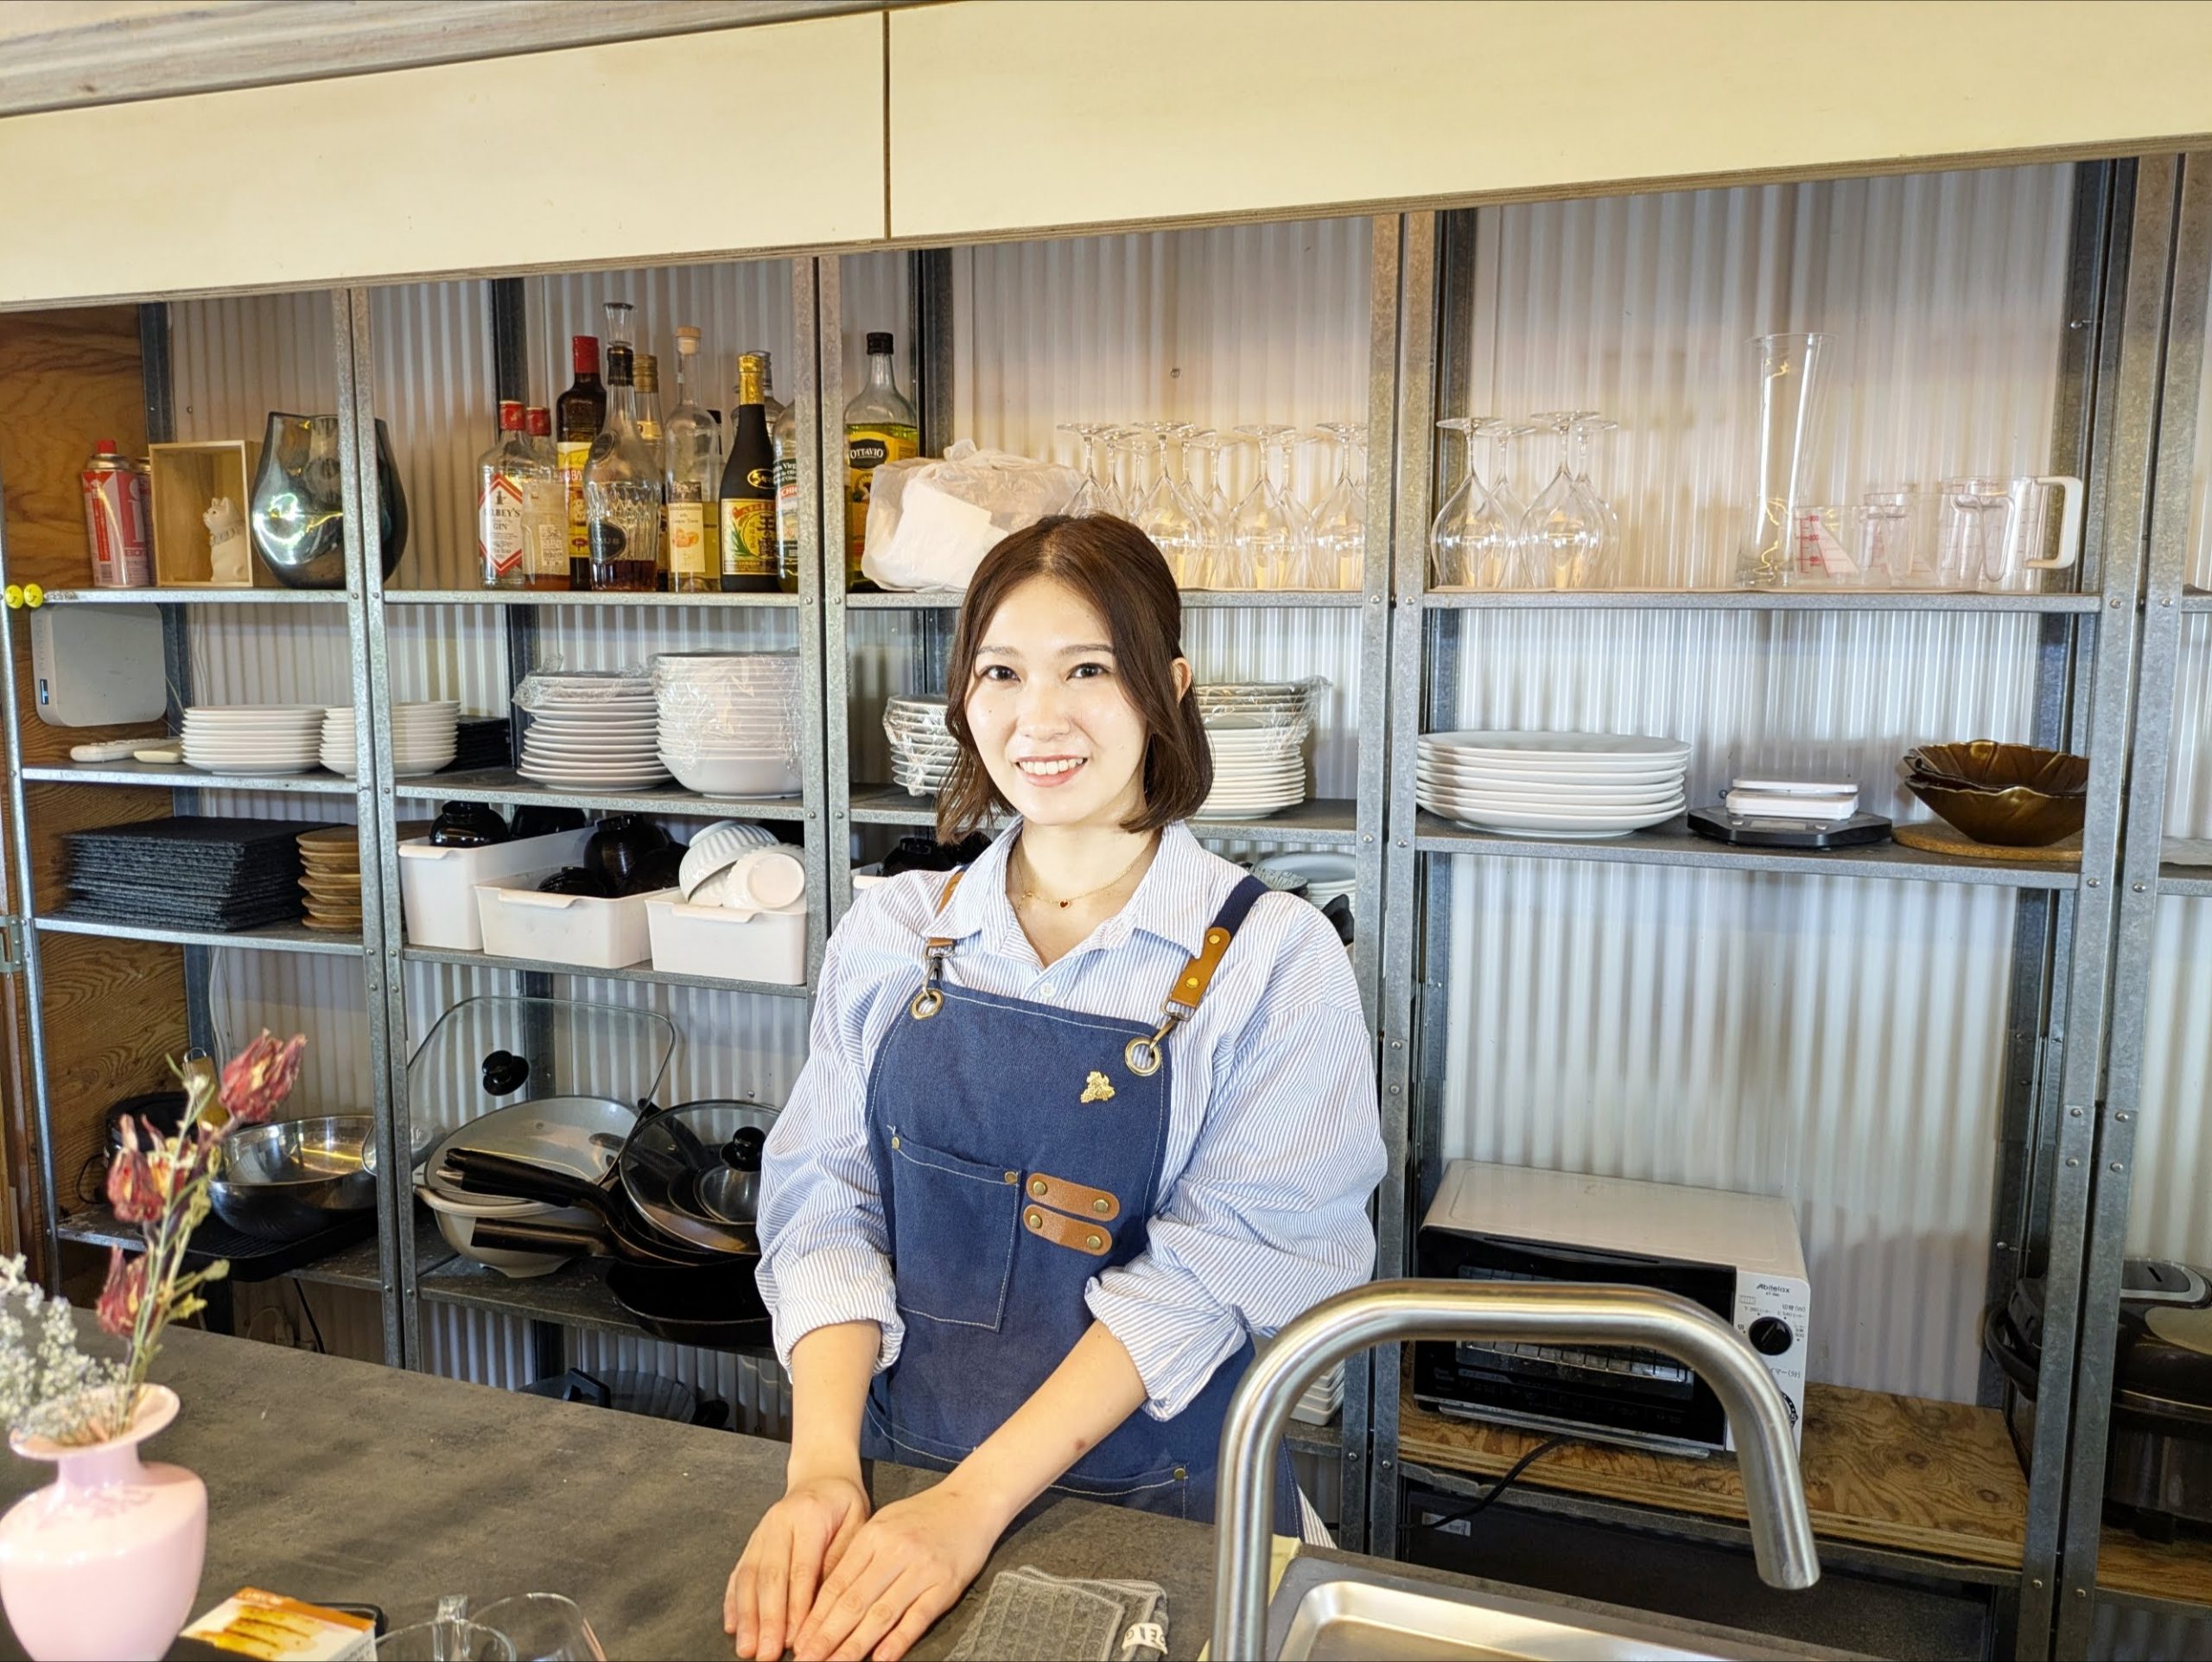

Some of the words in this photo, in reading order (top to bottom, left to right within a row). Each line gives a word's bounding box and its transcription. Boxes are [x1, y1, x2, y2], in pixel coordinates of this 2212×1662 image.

[850, 448, 884, 460] OTTAVIO
[483, 507, 521, 518] LBEY'S
[493, 522, 508, 531] GIN
[1756, 1283, 1790, 1294] Abitelax
